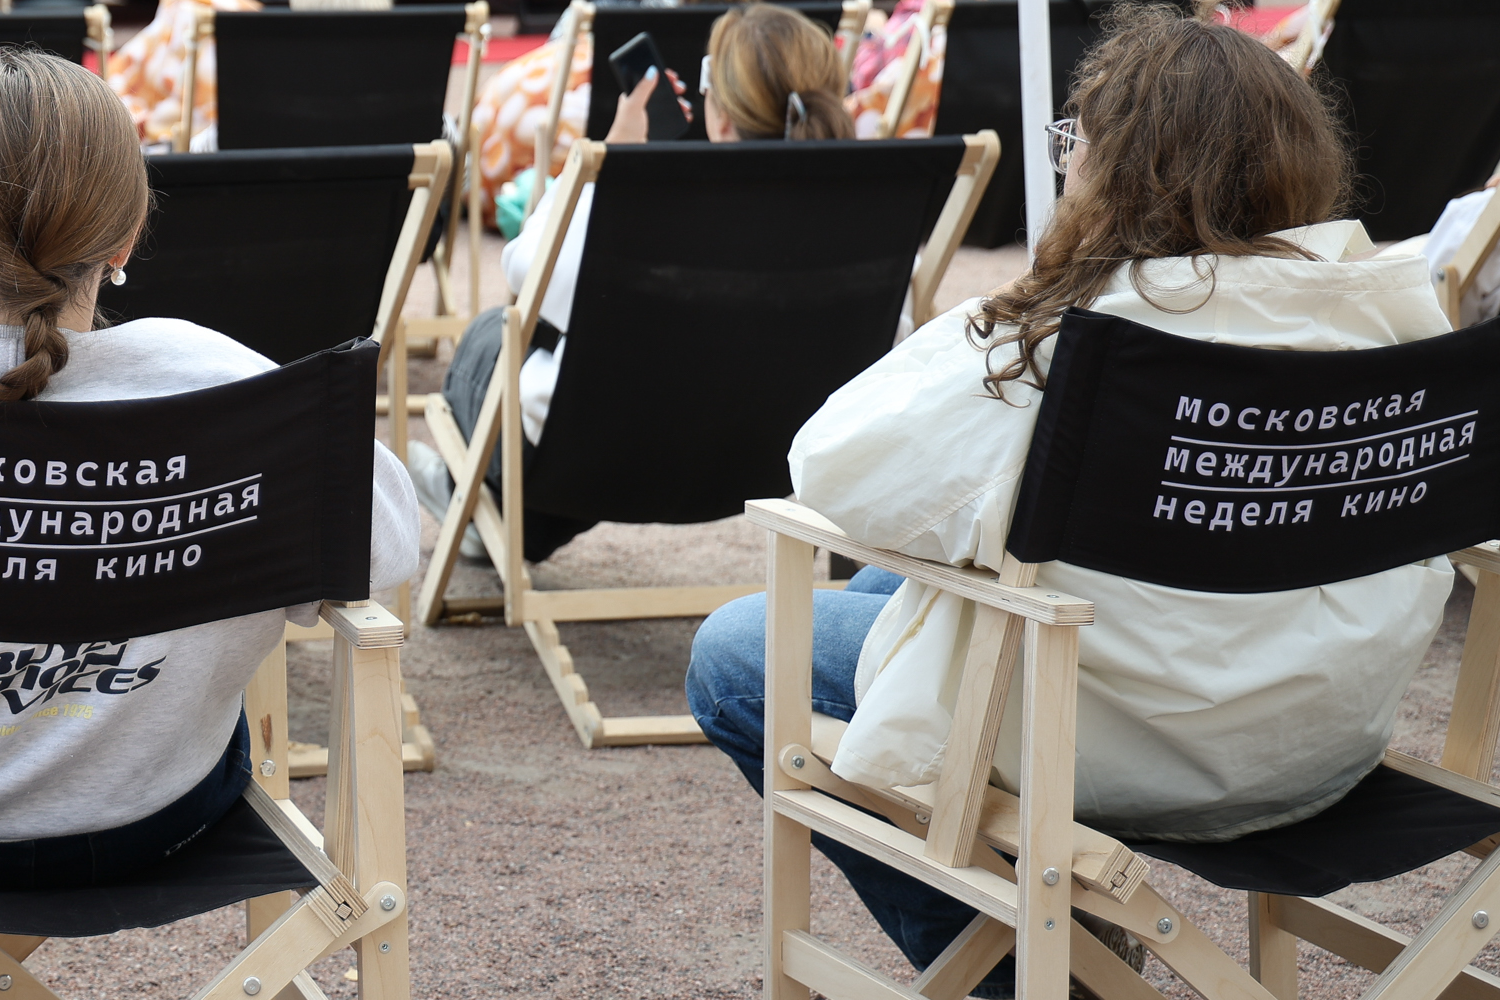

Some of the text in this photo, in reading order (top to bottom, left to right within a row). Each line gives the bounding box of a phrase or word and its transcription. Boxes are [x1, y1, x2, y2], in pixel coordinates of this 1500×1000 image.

[1153, 480, 1428, 532] неделя кино
[95, 544, 202, 581] кино
[62, 703, 95, 720] 1975
